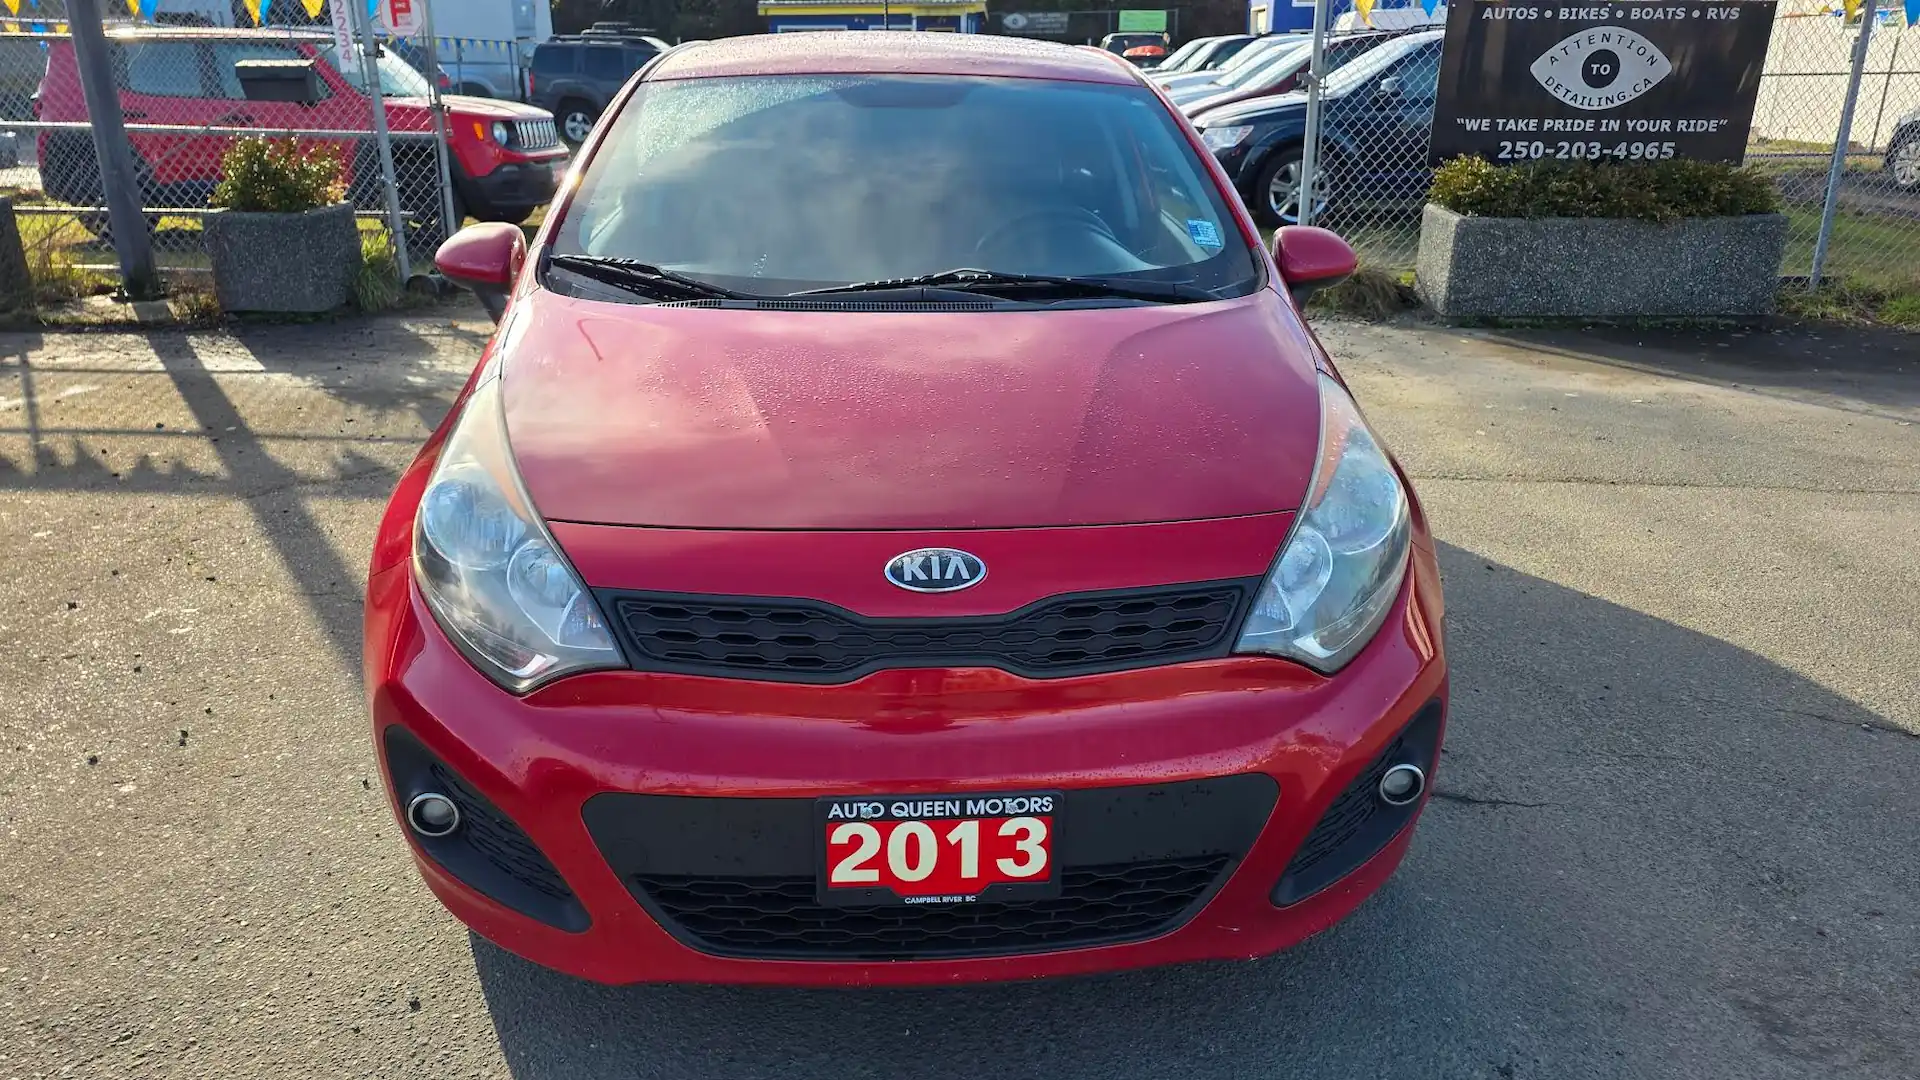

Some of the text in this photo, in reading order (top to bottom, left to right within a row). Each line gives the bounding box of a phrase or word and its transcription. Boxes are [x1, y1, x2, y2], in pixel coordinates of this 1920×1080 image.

[1482, 7, 1740, 20] AUTOS BIKES BOATS RVS
[1549, 33, 1658, 67] ATTENTION
[1590, 64, 1611, 76] TO
[1544, 76, 1653, 107] DETAILING.CA
[1496, 118, 1538, 132] TAKE
[1543, 118, 1596, 132] PRIDE
[1600, 119, 1620, 132] IN
[1625, 119, 1671, 132] YOUR
[1498, 140, 1676, 160] 250-203-4965
[903, 556, 971, 582] KIA
[828, 796, 1053, 819] AUTO QUEEN MOTORS
[830, 816, 1048, 883] 2013
[904, 896, 941, 904] CAMPBELL
